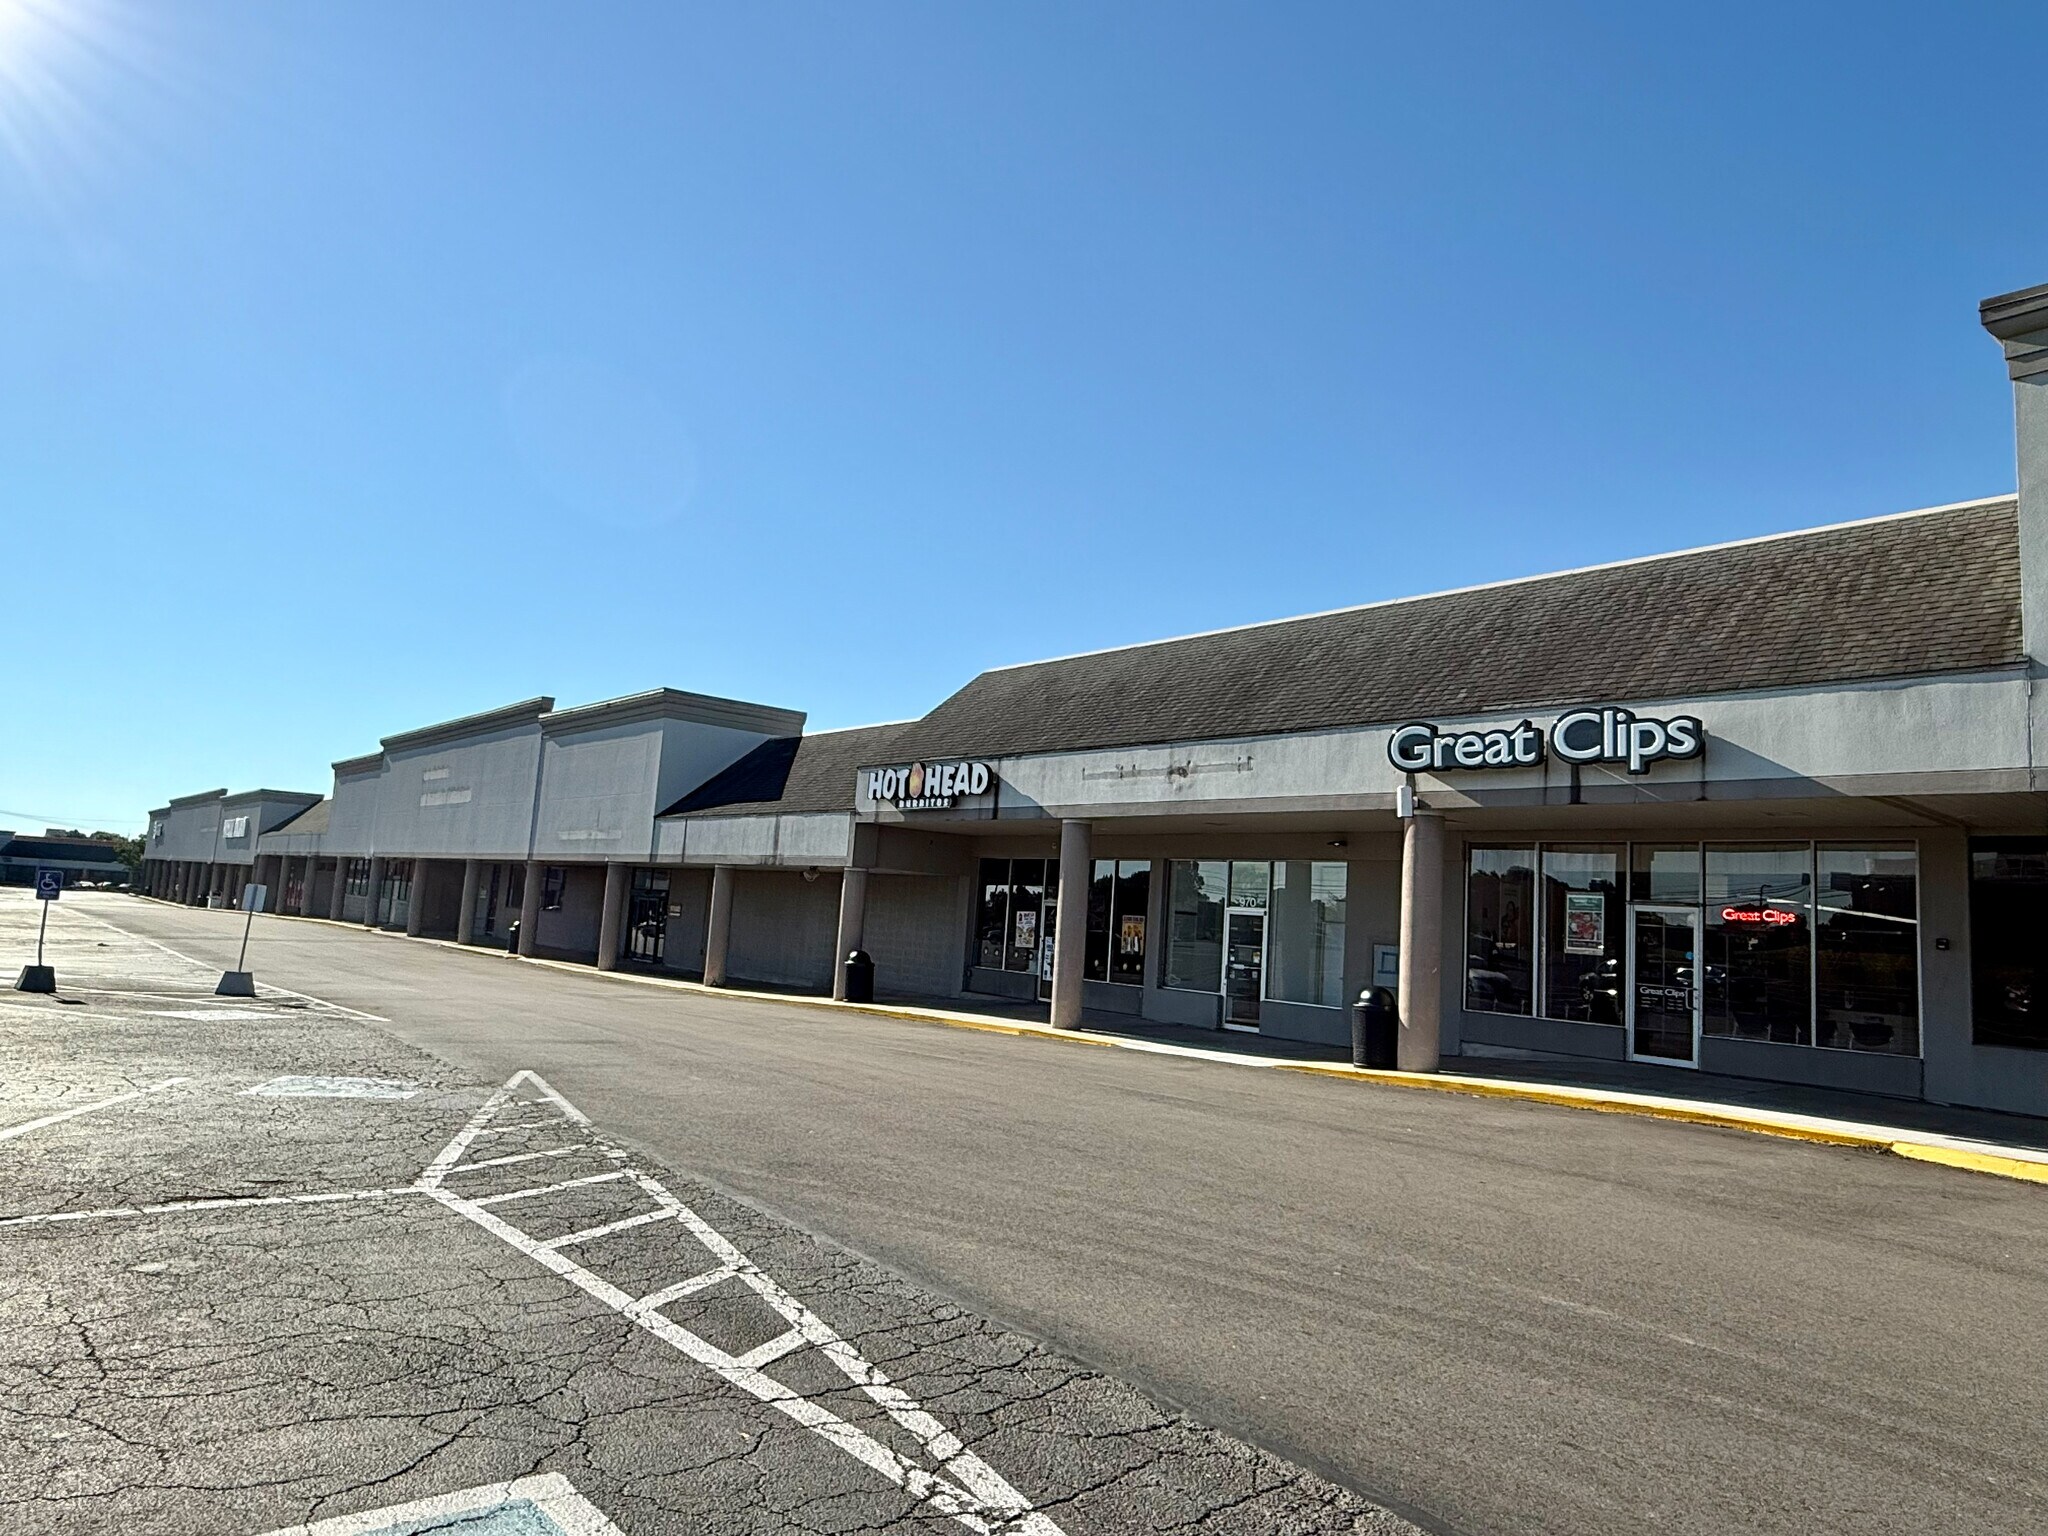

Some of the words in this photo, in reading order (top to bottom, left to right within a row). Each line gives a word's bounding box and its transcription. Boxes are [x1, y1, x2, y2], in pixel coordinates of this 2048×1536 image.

[1390, 725, 1536, 770] Great
[1552, 710, 1698, 771] Clips
[867, 768, 910, 800] HOT
[923, 762, 989, 798] HEAD
[898, 797, 950, 808] BURRITOS
[1239, 897, 1257, 908] 970
[1722, 908, 1760, 921] Great
[1762, 909, 1796, 925] Clips
[1640, 986, 1664, 996] Great
[1665, 988, 1685, 998] Clips
